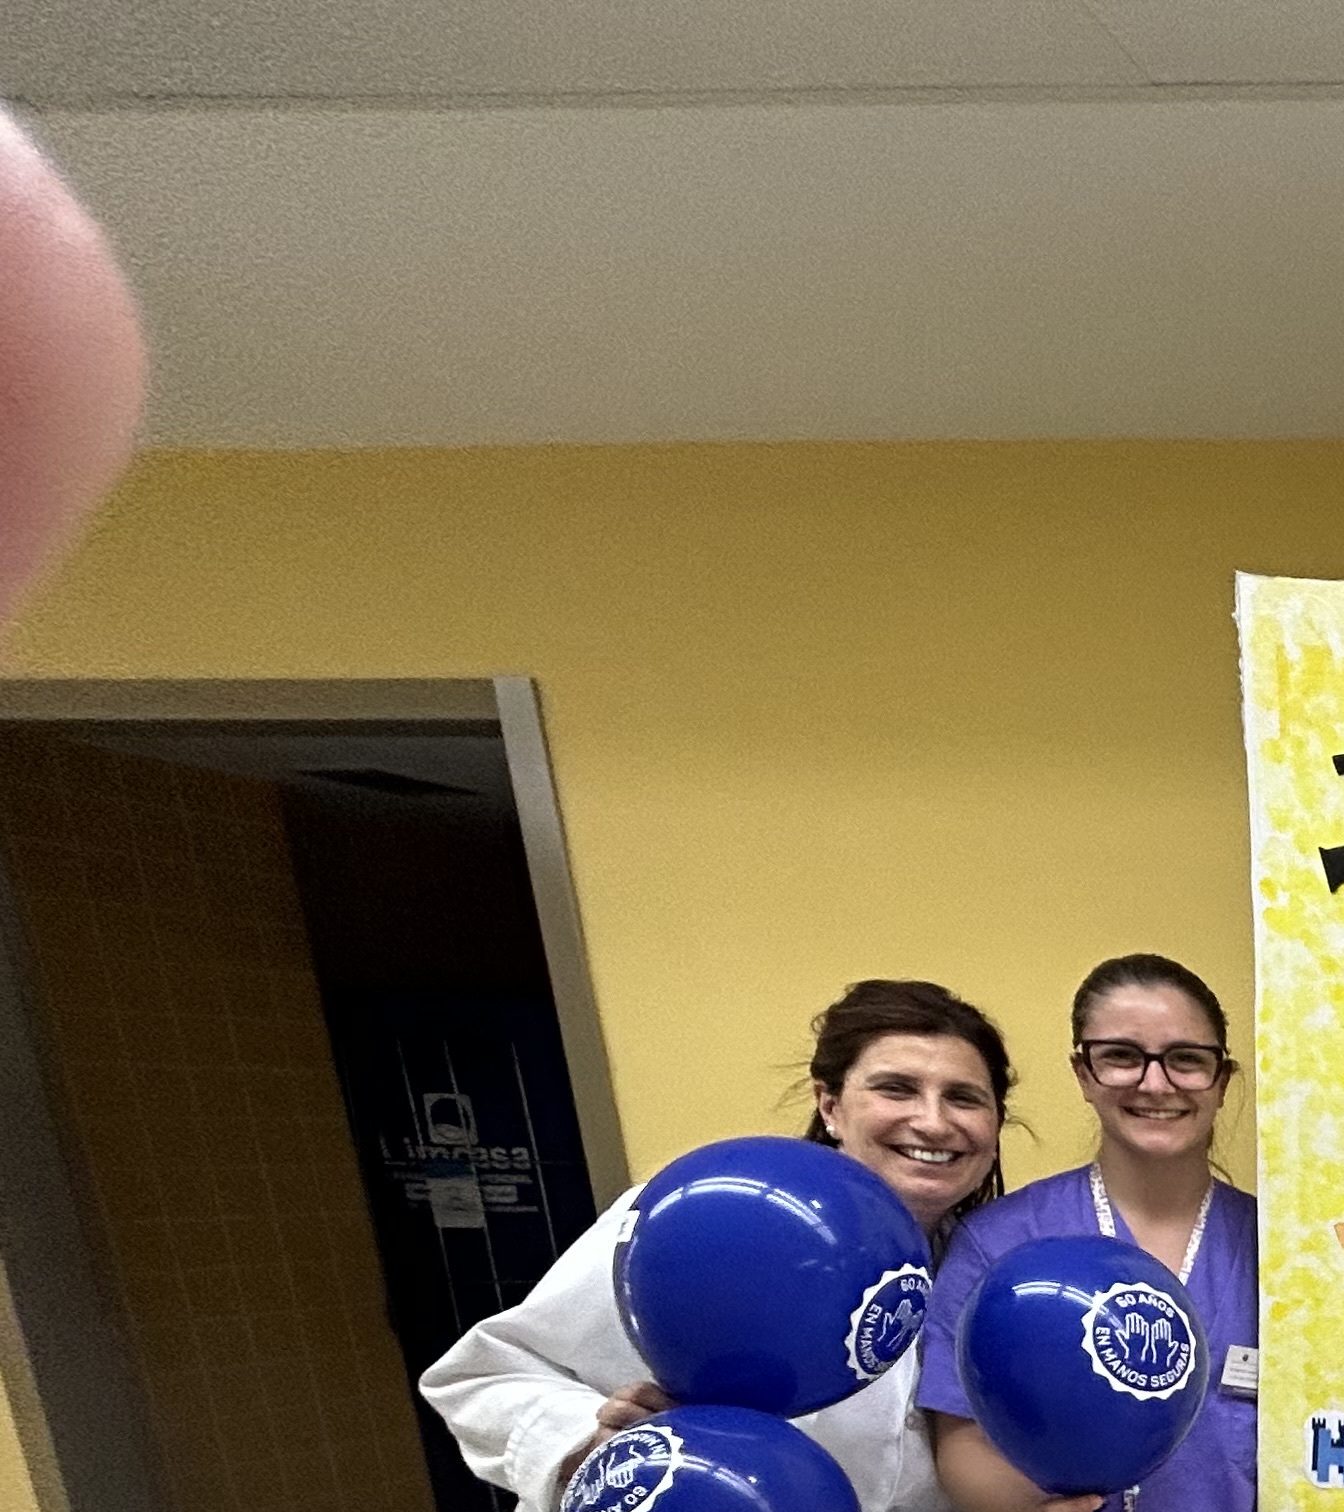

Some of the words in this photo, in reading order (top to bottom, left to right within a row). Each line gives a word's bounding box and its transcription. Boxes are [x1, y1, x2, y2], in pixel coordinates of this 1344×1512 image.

[865, 1303, 882, 1324] EN
[1115, 1294, 1136, 1308] 60
[1138, 1293, 1175, 1318] AÑOS
[1096, 1327, 1111, 1345] EN
[1100, 1348, 1148, 1387] MANOS
[1150, 1343, 1189, 1387] SEGURAS
